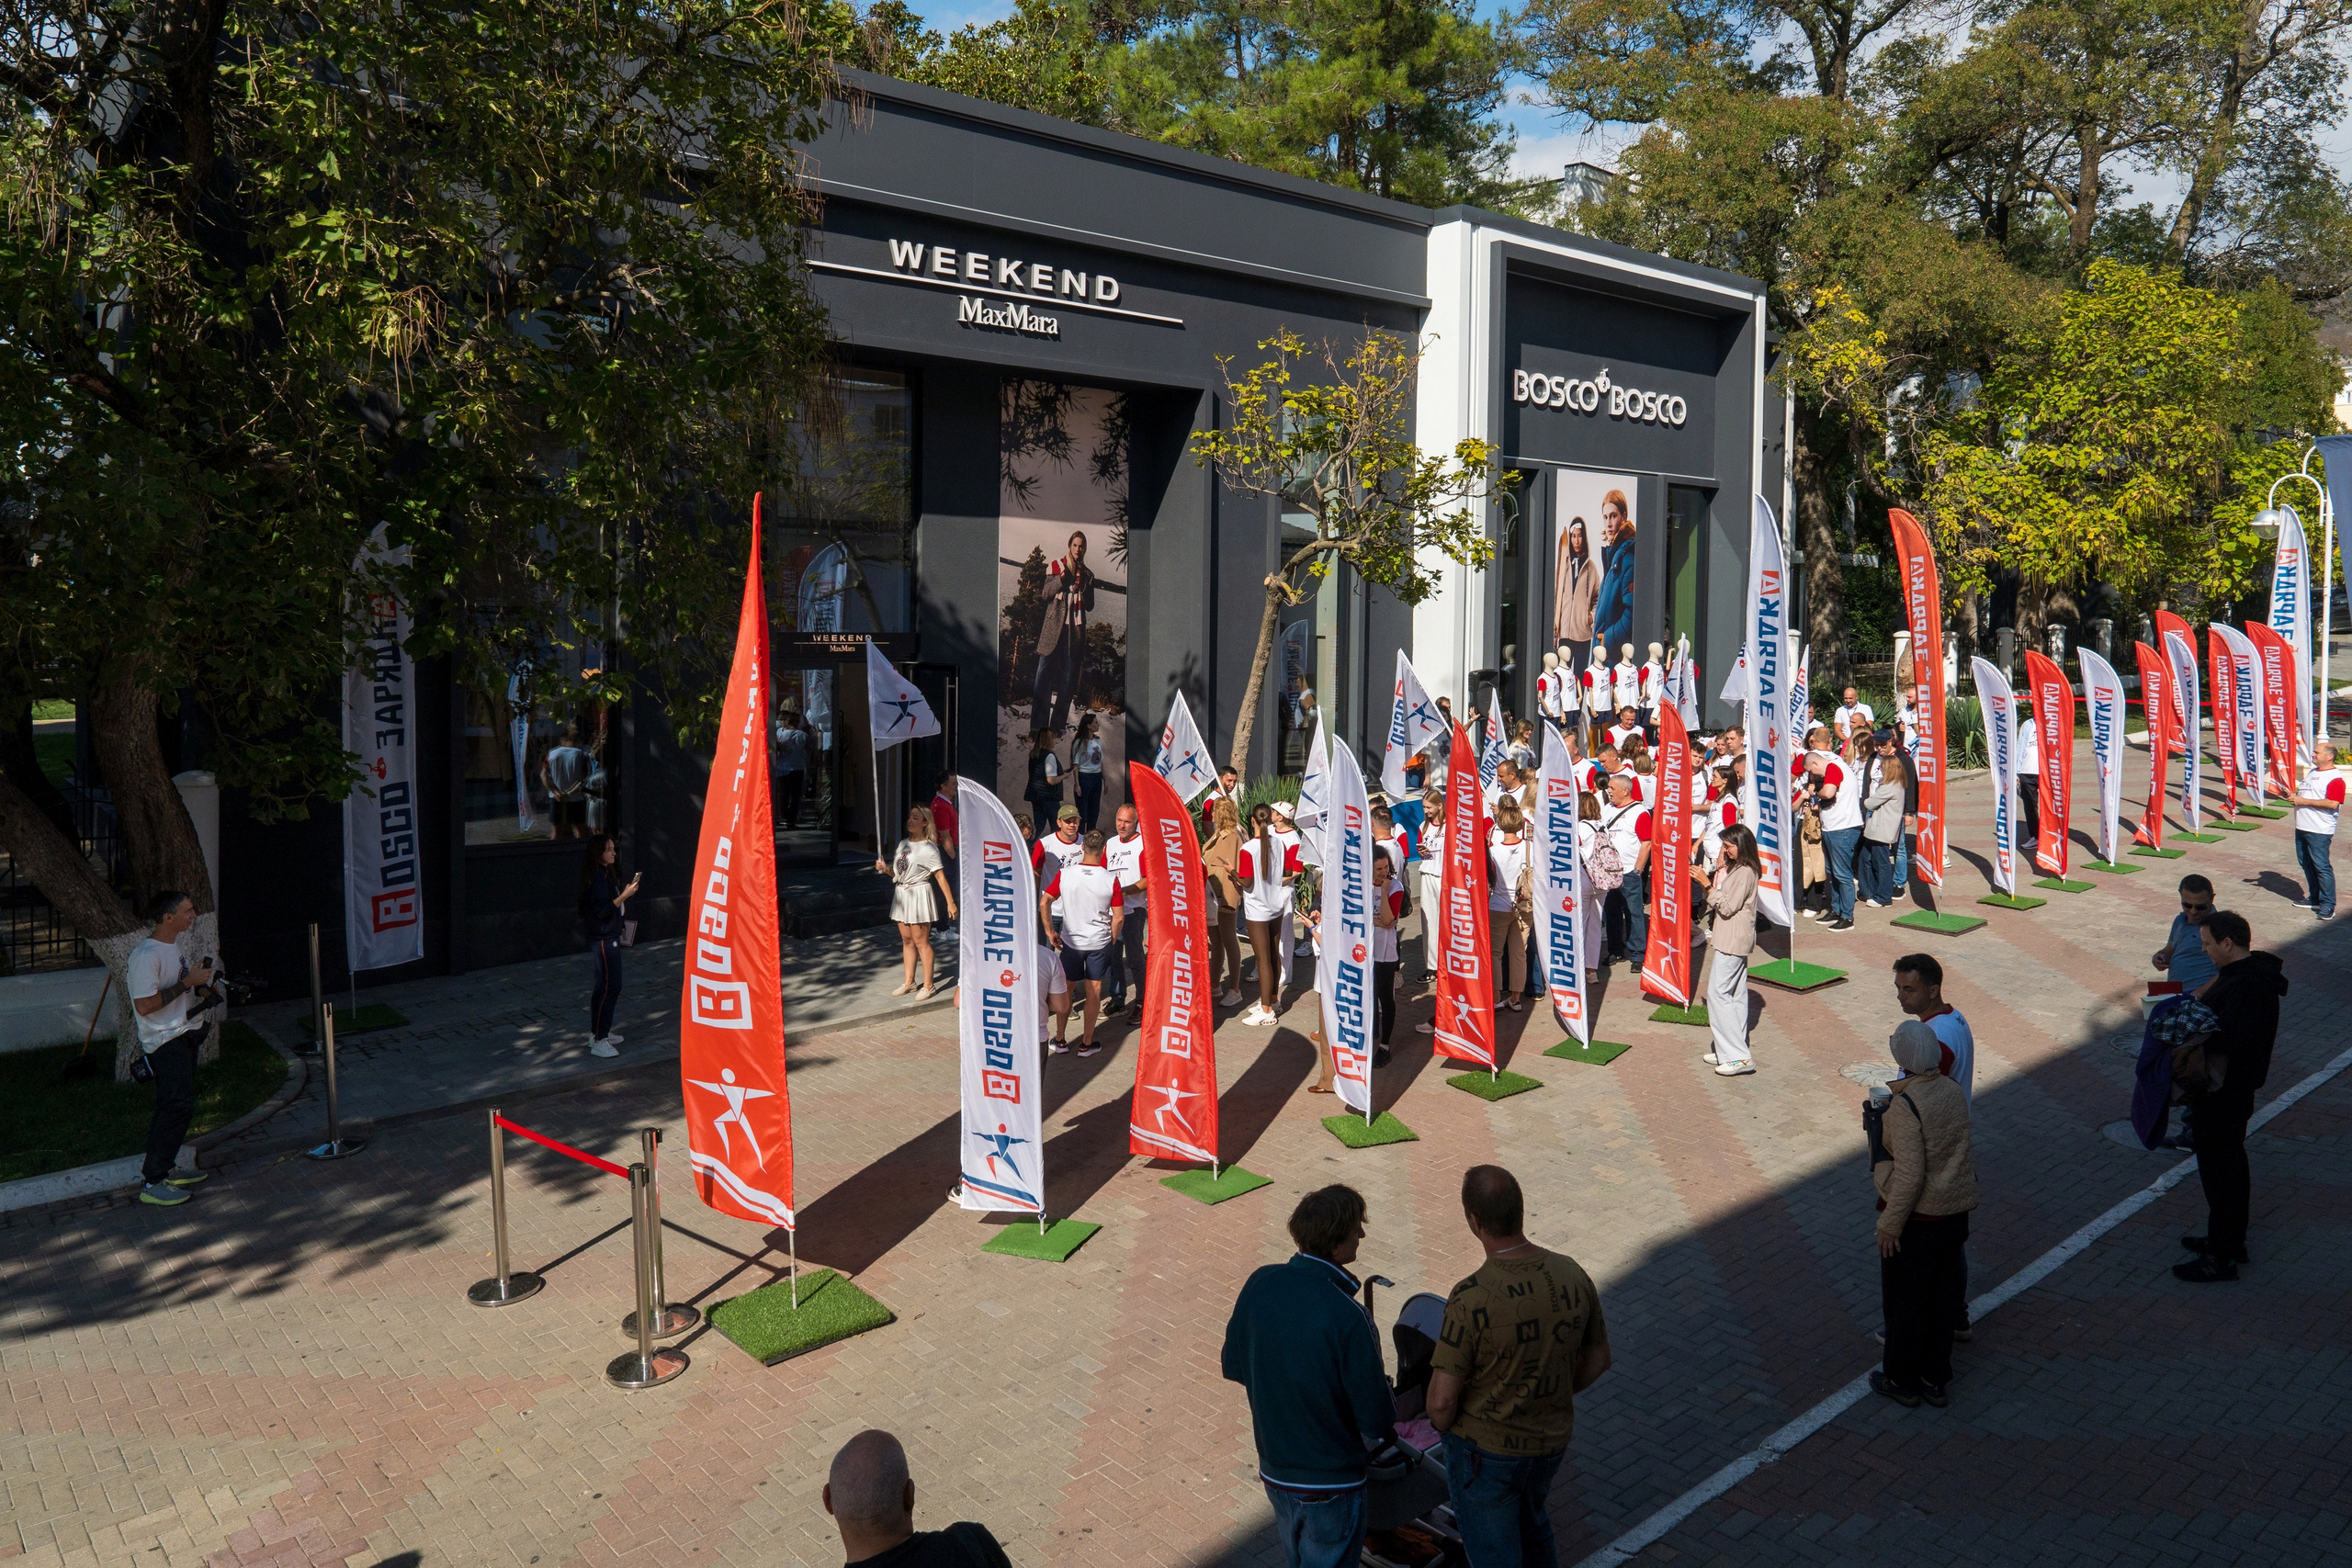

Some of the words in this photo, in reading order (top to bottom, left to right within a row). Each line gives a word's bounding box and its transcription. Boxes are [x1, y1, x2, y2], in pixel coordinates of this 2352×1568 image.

[888, 238, 1121, 302] WEEKEND
[957, 295, 1058, 335] MaxMara
[1513, 368, 1599, 412] BOSCO
[1609, 385, 1687, 425] BOSCO
[812, 634, 872, 642] WEEKEND
[371, 780, 418, 934] BOSCO
[1543, 1269, 1560, 1313] EXCHANGE
